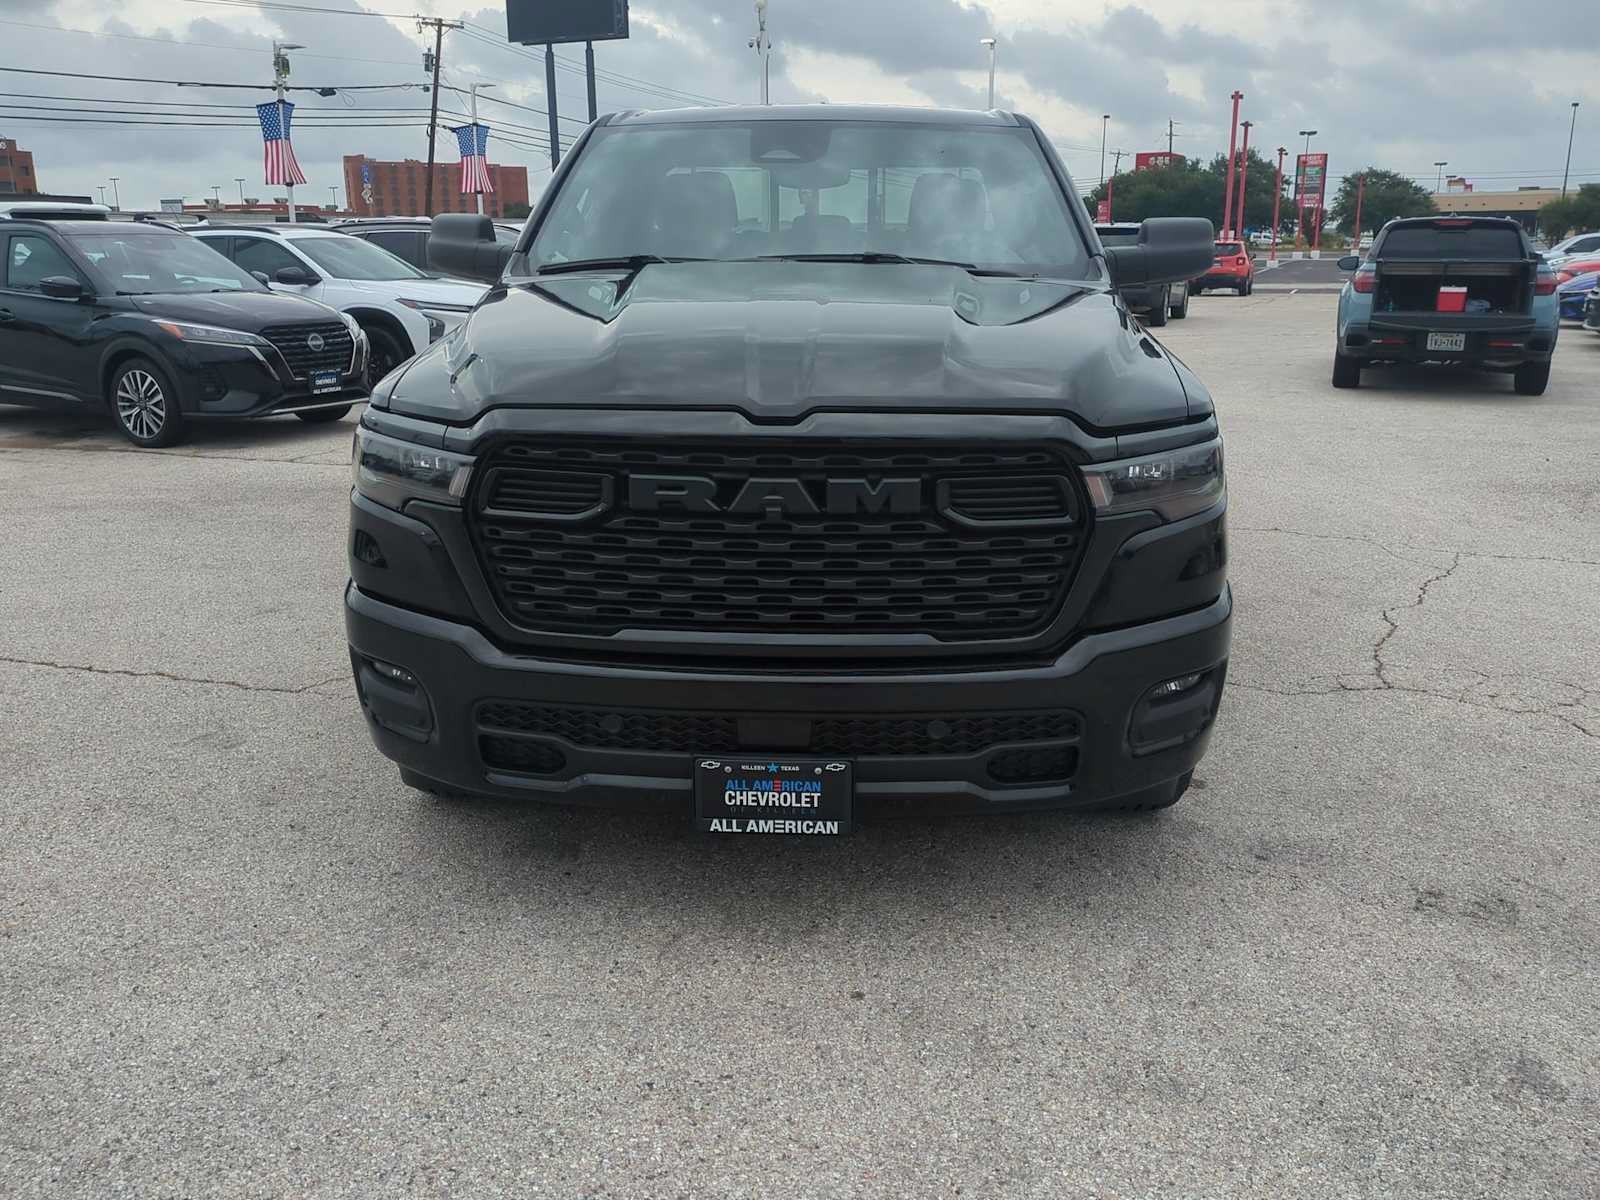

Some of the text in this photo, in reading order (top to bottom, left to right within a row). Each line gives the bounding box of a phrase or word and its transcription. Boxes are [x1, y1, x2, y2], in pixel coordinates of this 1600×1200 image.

[629, 474, 921, 513] RAM
[726, 780, 821, 792] ALL AMERICAN
[724, 790, 821, 808] CHEVROLET
[709, 818, 839, 835] ALL AMERICAN
